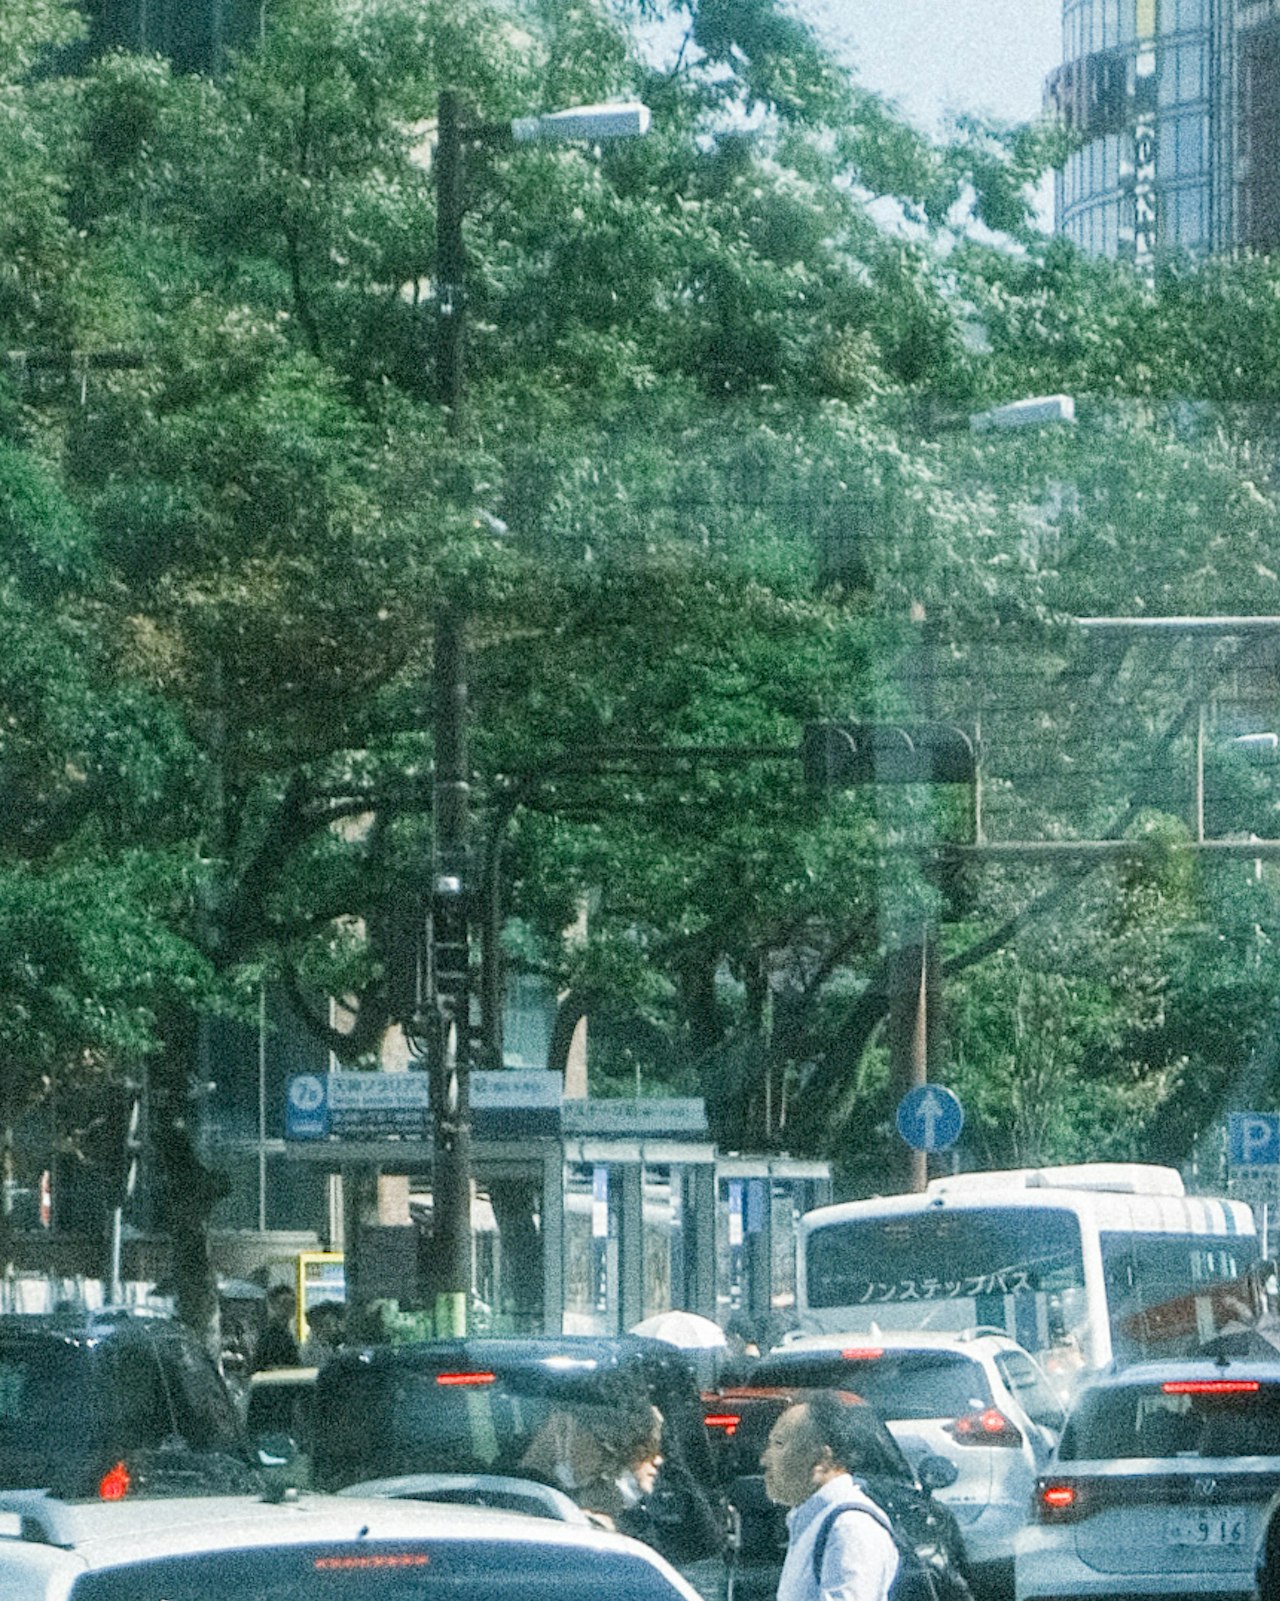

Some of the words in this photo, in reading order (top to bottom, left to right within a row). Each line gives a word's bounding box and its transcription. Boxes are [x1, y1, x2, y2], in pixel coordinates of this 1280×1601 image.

[1242, 1120, 1272, 1161] P
[859, 1271, 1032, 1302] ノンステップバス
